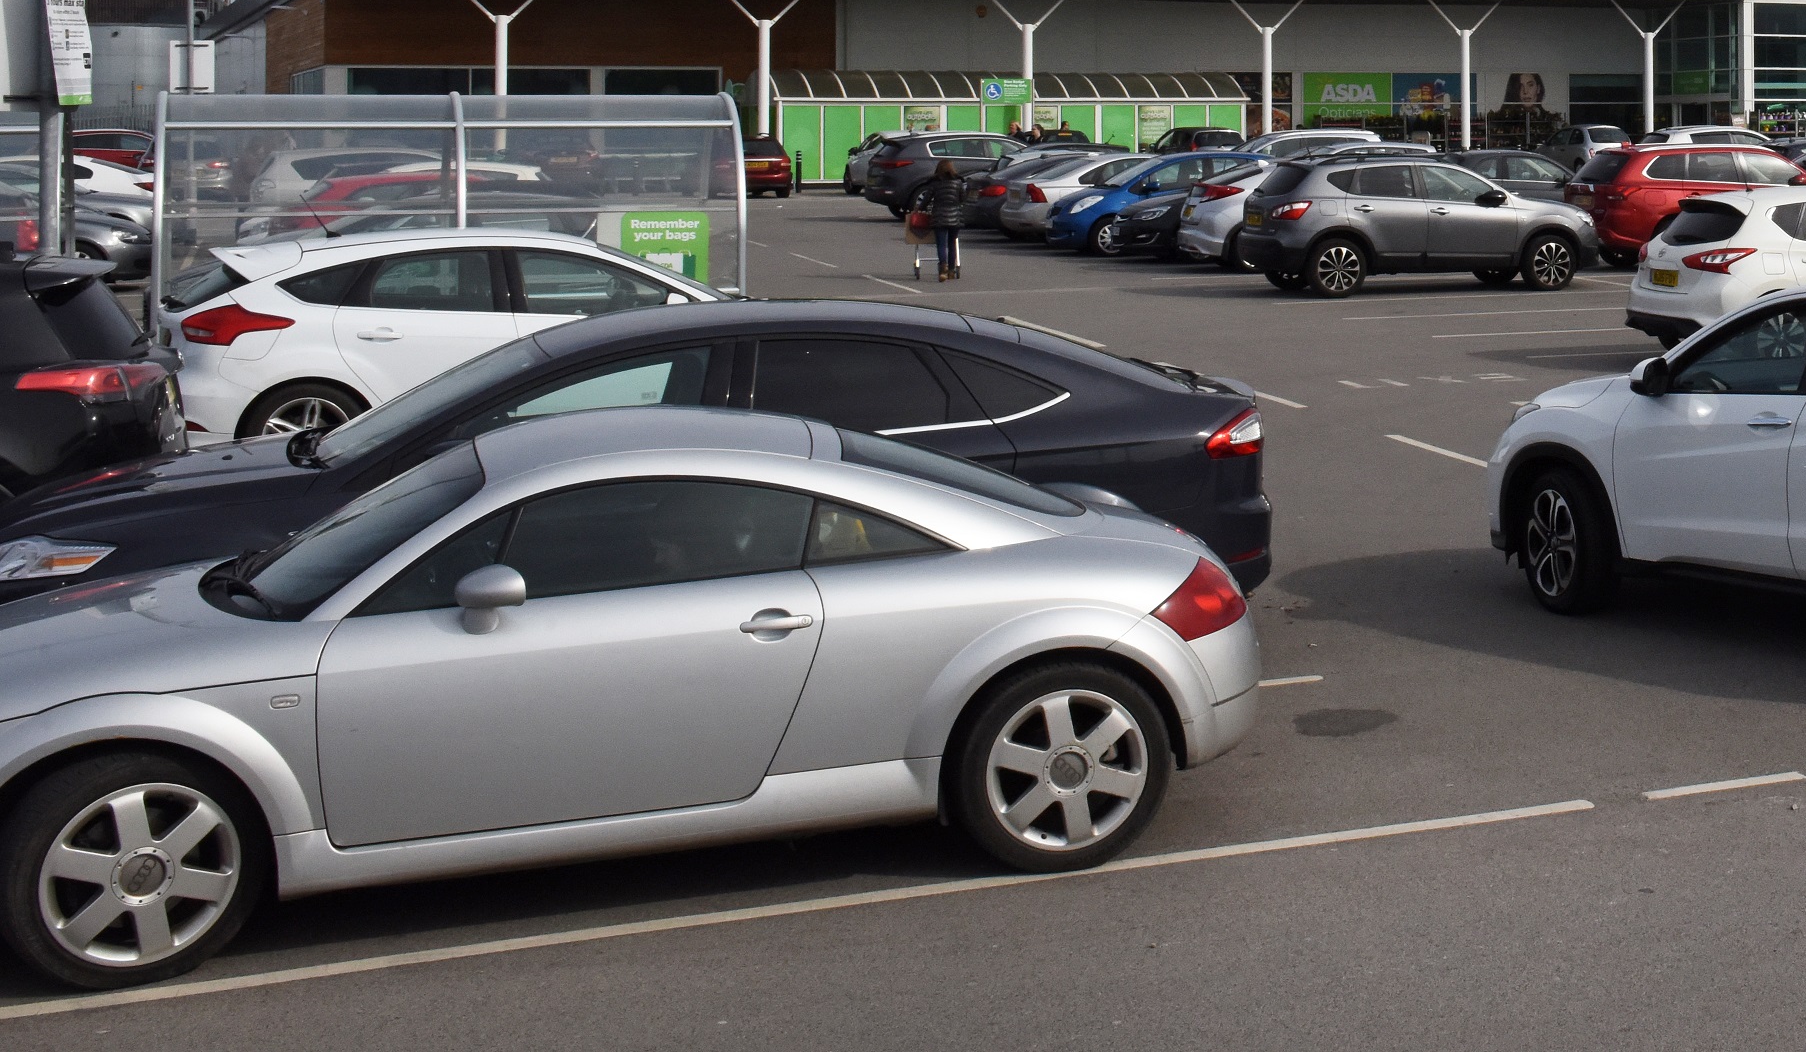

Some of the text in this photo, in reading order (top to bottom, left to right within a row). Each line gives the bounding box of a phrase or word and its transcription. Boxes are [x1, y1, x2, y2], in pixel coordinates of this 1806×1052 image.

[1320, 84, 1377, 102] ASDA
[1318, 106, 1376, 118] Opticians
[631, 219, 700, 228] Remember
[634, 230, 697, 241] your bags
